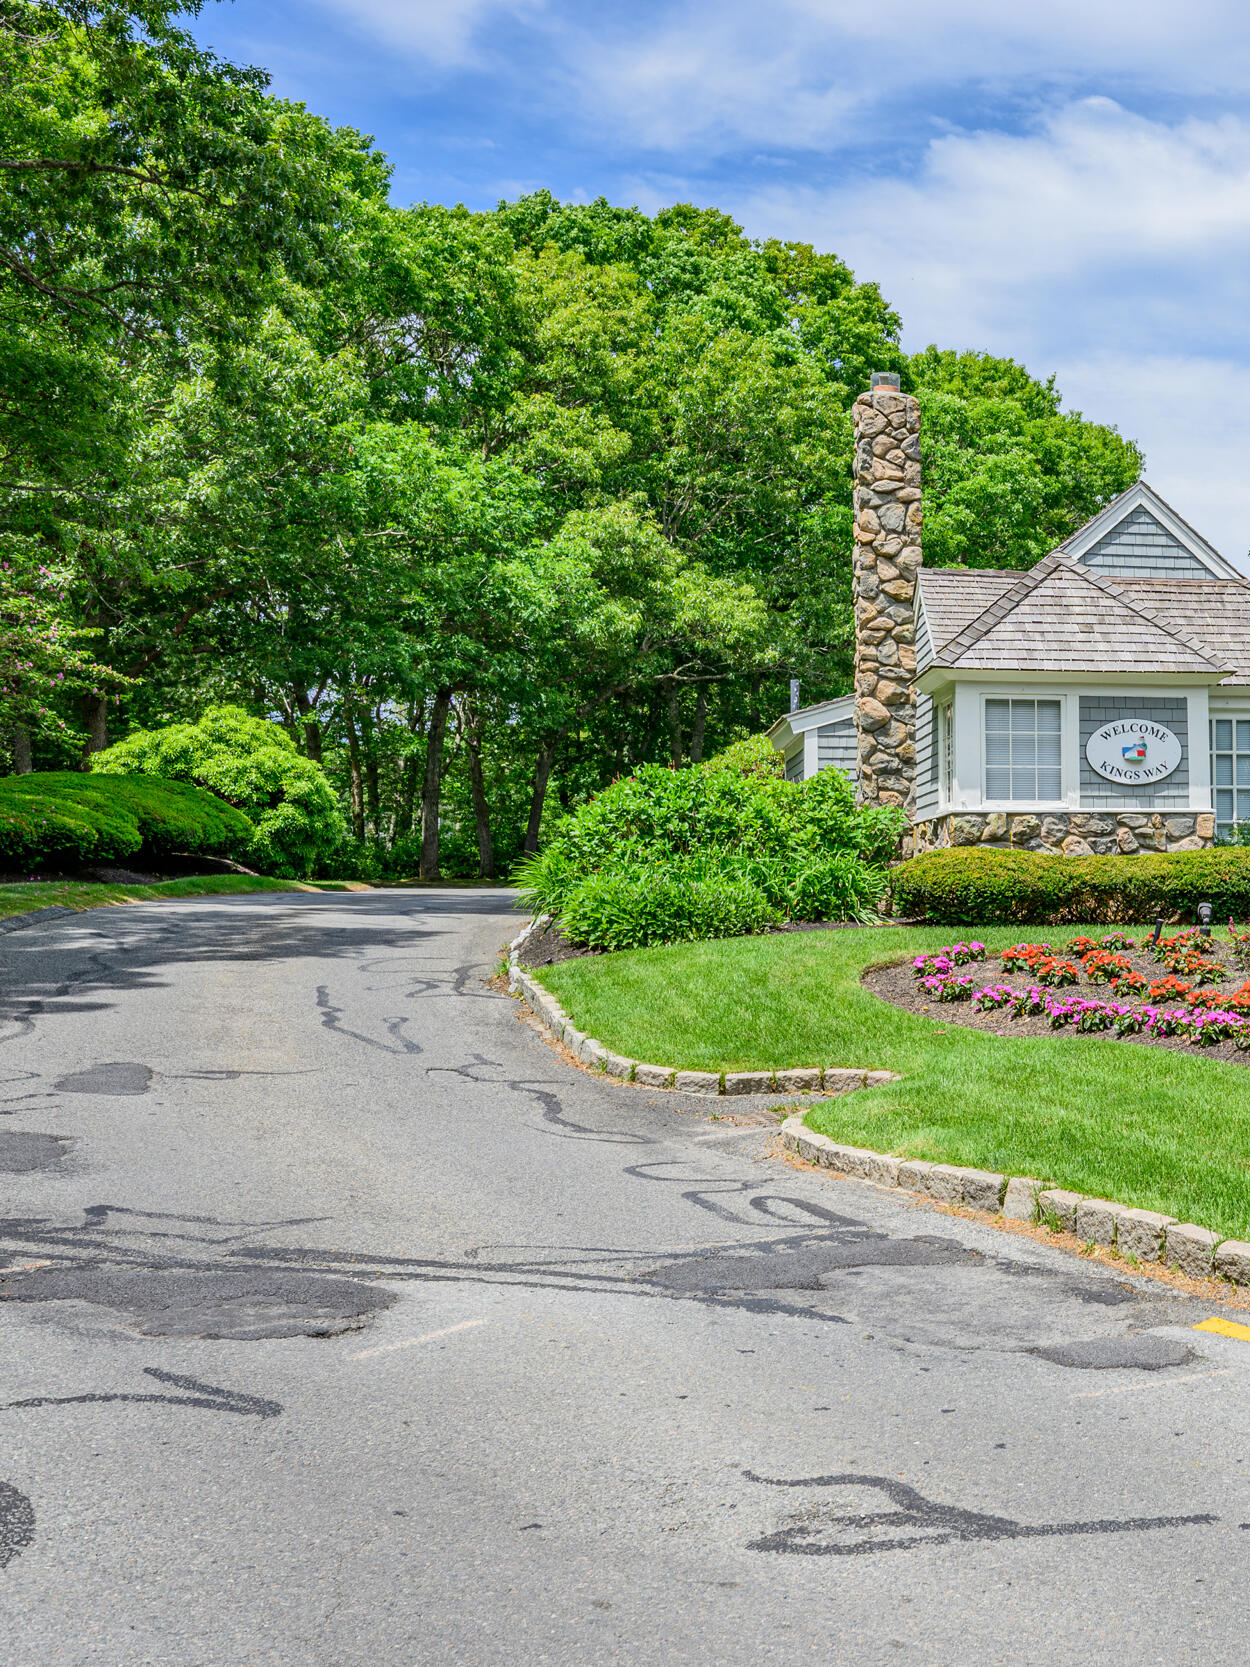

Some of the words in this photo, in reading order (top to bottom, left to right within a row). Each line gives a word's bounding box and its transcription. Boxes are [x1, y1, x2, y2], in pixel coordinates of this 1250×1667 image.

[1100, 723, 1168, 742] WELCOME
[1100, 760, 1140, 780] KINGS
[1143, 760, 1168, 778] WAY
